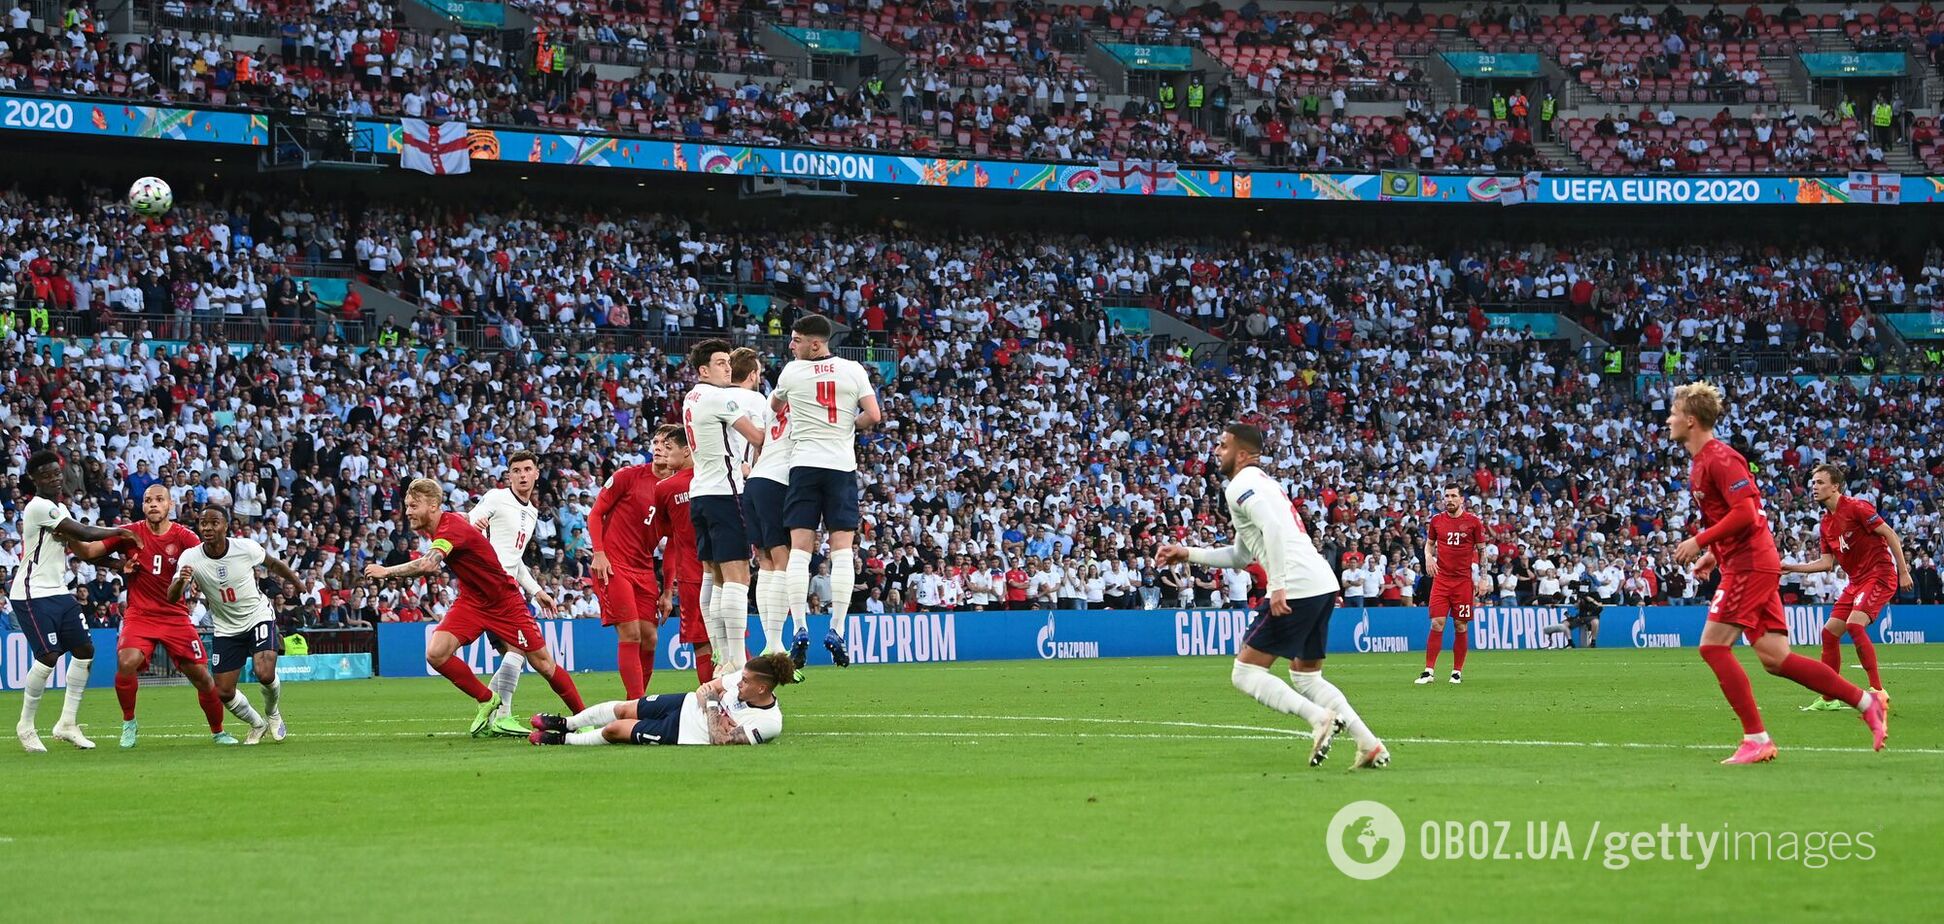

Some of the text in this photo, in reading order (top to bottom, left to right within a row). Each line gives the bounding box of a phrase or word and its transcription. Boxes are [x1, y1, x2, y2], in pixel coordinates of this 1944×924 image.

[447, 3, 464, 13] 230
[805, 31, 820, 40] 231
[1134, 48, 1151, 56] 232
[1478, 56, 1496, 64] 233
[1841, 56, 1859, 64] 234
[5, 100, 73, 129] 2020
[781, 152, 874, 179] LONDON
[1551, 180, 1760, 202] UEFA EURO 2020
[1493, 316, 1510, 325] 128
[814, 363, 835, 375] RICE
[815, 381, 838, 424] 4
[685, 407, 697, 452] 6
[643, 505, 656, 526] 3
[514, 530, 526, 551] 19
[1447, 532, 1460, 545] 23
[152, 554, 163, 575] 9
[219, 587, 238, 604] 10
[1458, 604, 1471, 618] 23
[254, 623, 269, 641] 10
[517, 629, 528, 648] 4
[840, 613, 957, 663] AZPROM
[1648, 633, 1681, 648] GAZPROM
[1894, 630, 1925, 644] GAZPROM
[191, 639, 203, 659] 9
[1057, 641, 1099, 659] GAZPROM
[1372, 636, 1409, 653] GAZPROM
